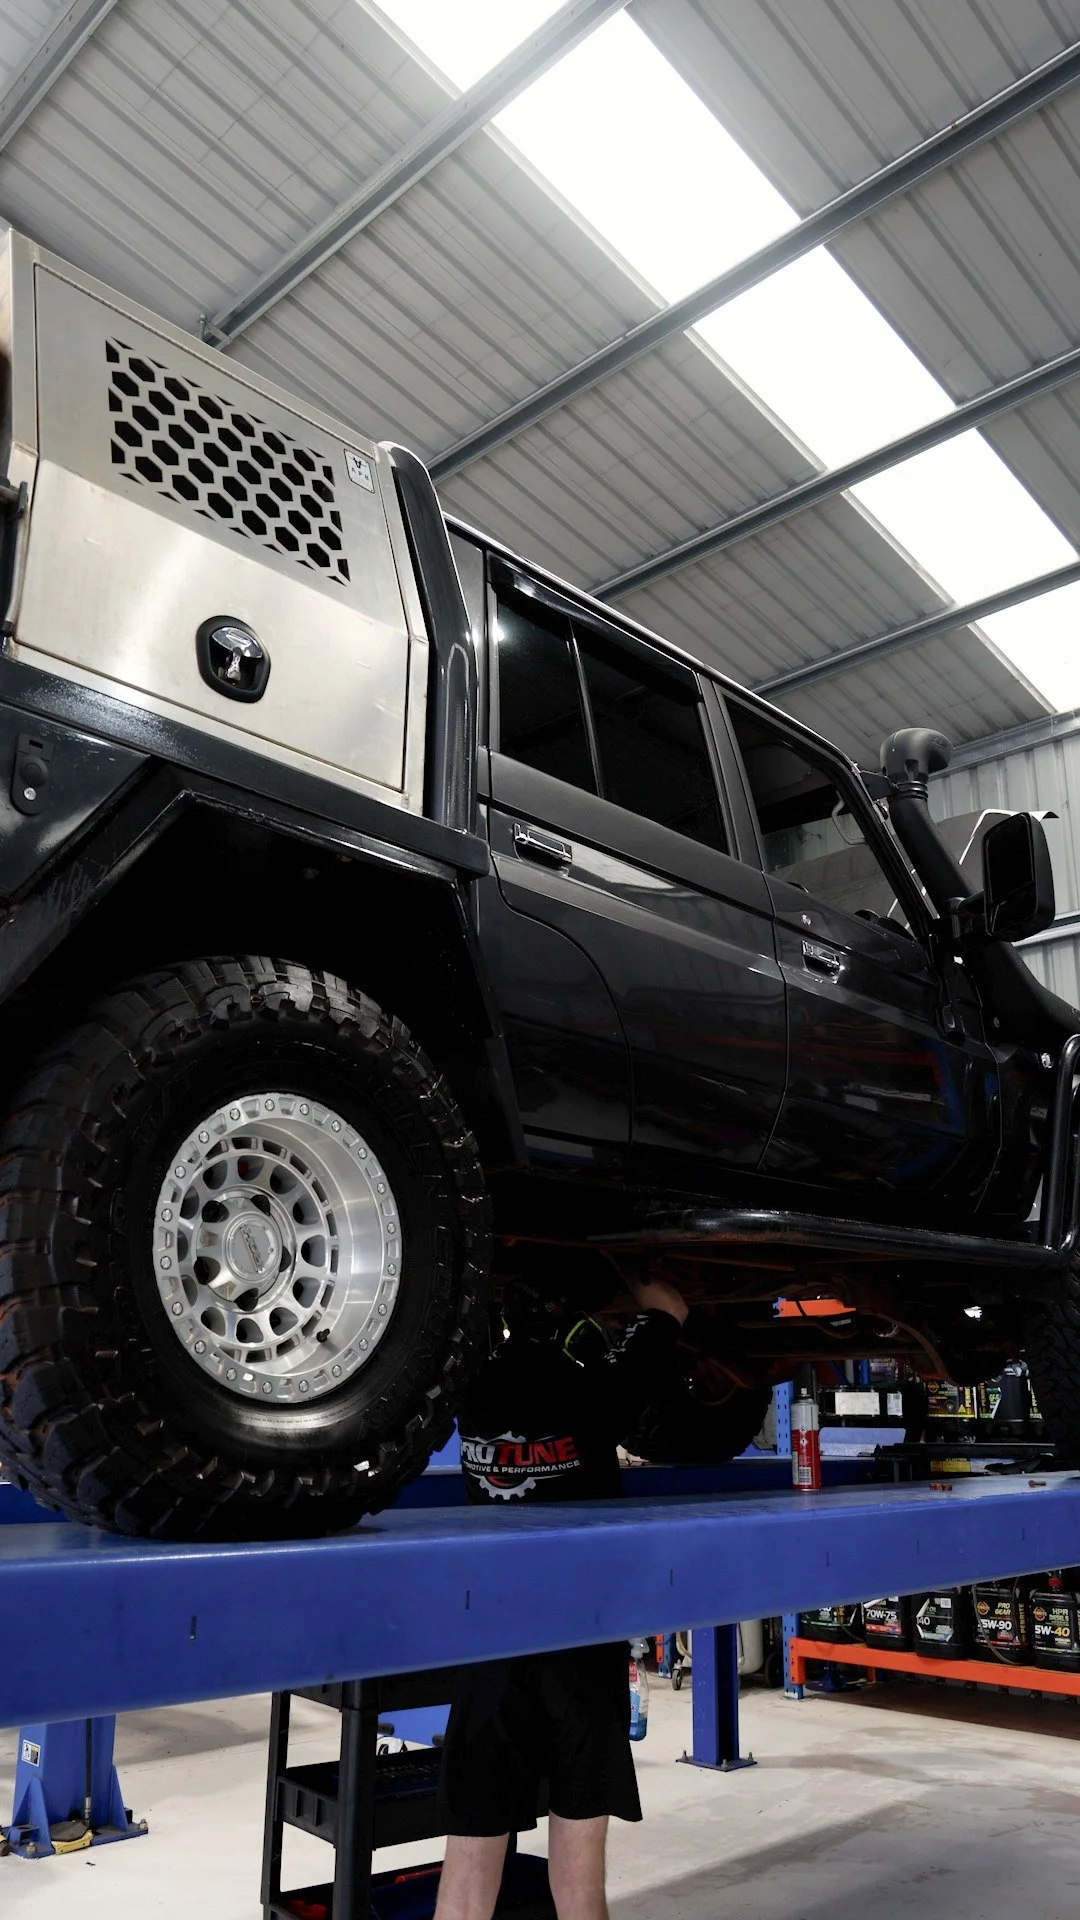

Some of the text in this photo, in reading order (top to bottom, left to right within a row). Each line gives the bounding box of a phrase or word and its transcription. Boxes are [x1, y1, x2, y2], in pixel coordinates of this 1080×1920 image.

[501, 1459, 580, 1474] PERFORMANCE
[866, 1609, 897, 1619] 70W-75
[994, 1608, 1012, 1616] GEAR
[1052, 1608, 1069, 1616] HPR
[1034, 1624, 1071, 1637] 5W-40
